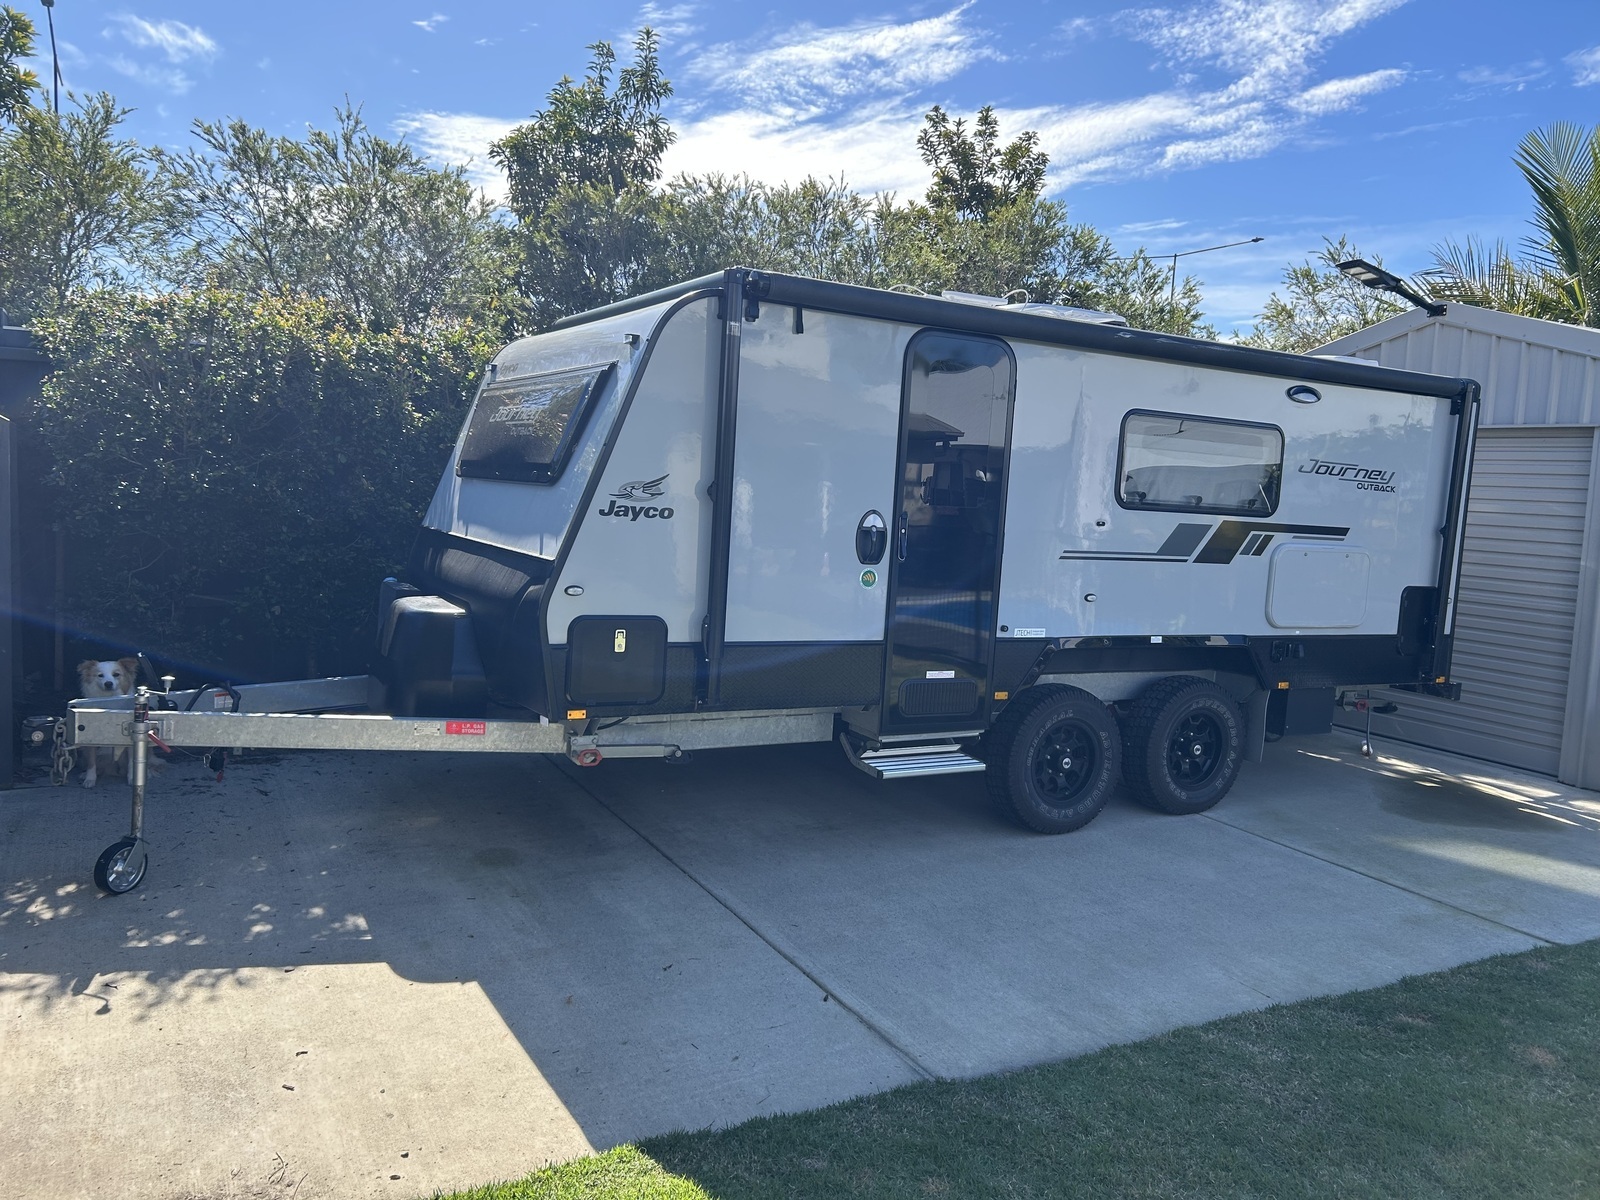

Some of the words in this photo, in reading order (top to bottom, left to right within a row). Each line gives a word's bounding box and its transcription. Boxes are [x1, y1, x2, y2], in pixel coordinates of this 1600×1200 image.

[489, 406, 541, 424] Journey
[1298, 458, 1396, 484] Journey
[1356, 482, 1396, 493] OUTBACK
[598, 500, 675, 522] Jayco
[1015, 629, 1031, 637] JTECH
[1077, 730, 1112, 814] ADVENTURO
